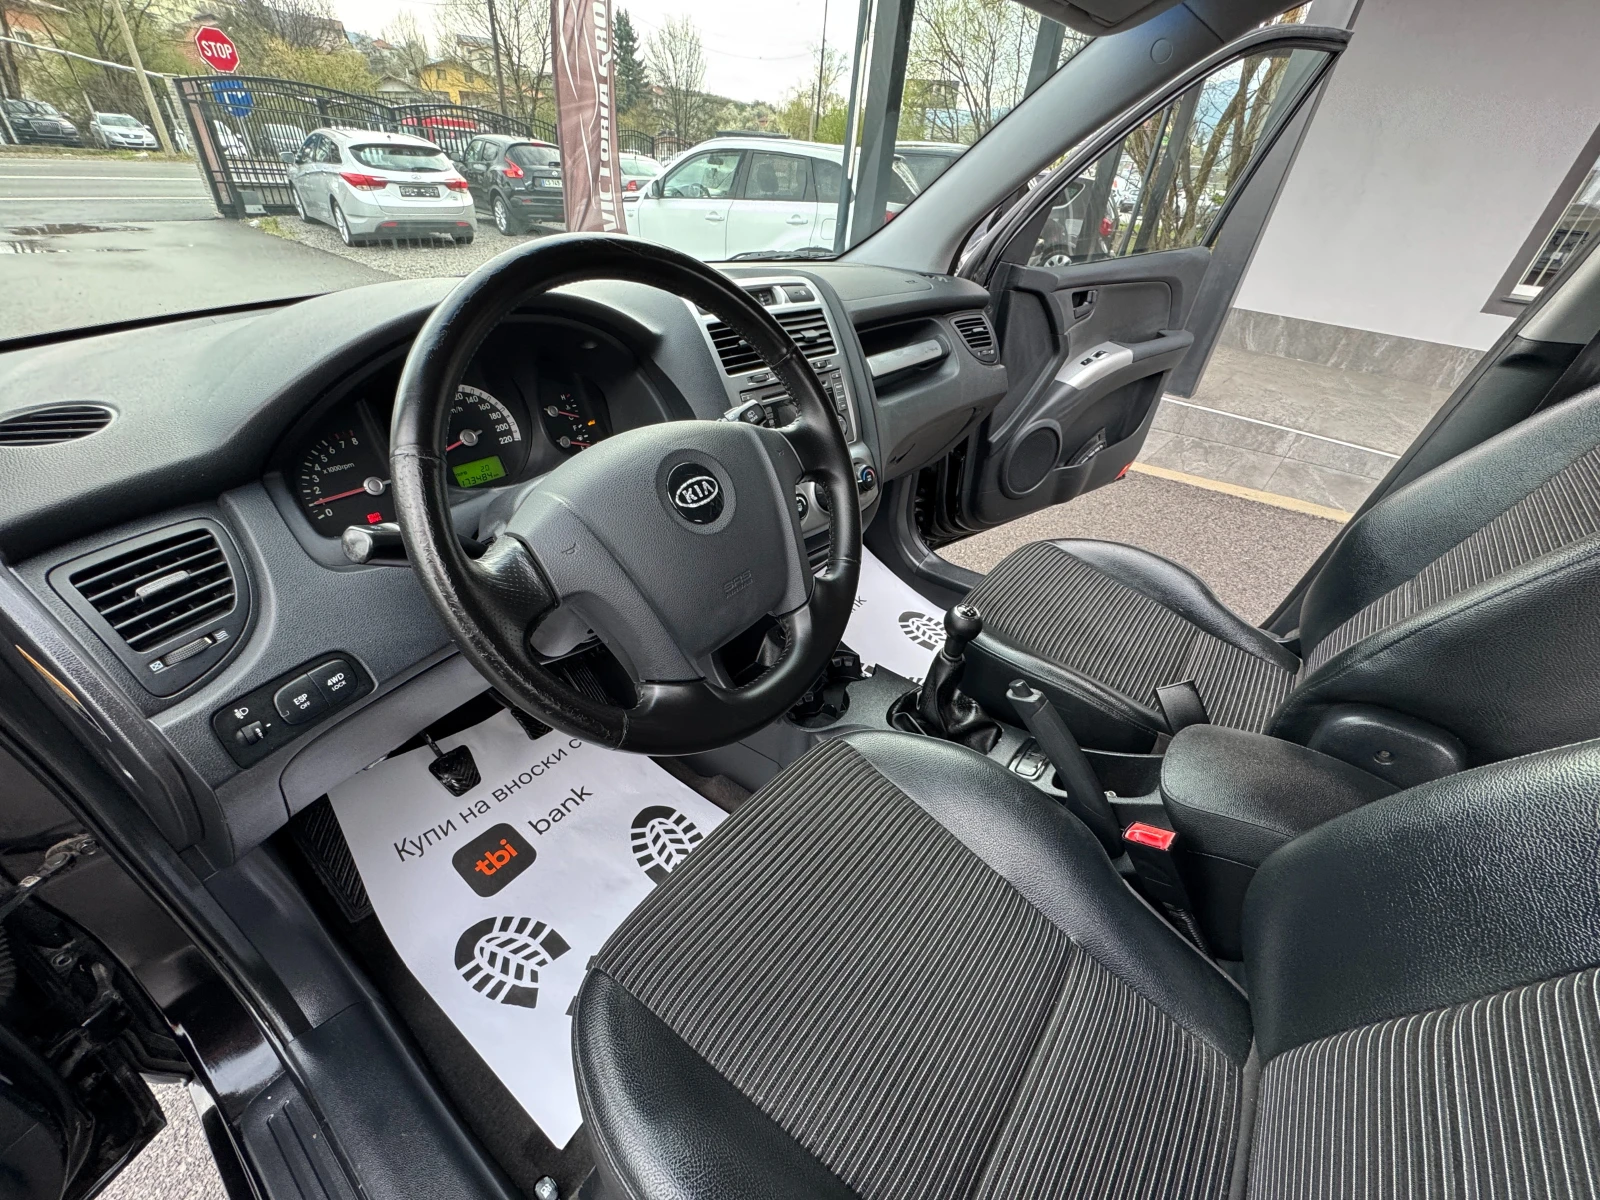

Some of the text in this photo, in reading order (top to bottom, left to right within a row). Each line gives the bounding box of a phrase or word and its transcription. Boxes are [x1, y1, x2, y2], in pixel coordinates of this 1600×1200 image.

[201, 40, 233, 59] STOP
[593, 0, 617, 232] VICTORIA GRO
[465, 395, 479, 404] 140
[478, 402, 491, 411] 160
[489, 411, 502, 420] 180
[495, 422, 509, 432] 200
[339, 440, 345, 449] 7
[351, 437, 359, 446] 8
[499, 435, 513, 445] 220
[328, 446, 336, 455] 6
[320, 454, 328, 463] 5
[314, 463, 321, 471] 4
[312, 475, 320, 483] 3
[461, 472, 493, 487] 173484
[313, 486, 321, 494] 2
[682, 480, 714, 504] KIA
[325, 508, 333, 517] 0
[327, 672, 344, 686] 4WD
[331, 680, 347, 691] LOCK
[293, 693, 308, 705] ESP
[300, 701, 310, 710] OFF
[393, 818, 458, 862] Купи
[459, 799, 491, 823] на
[491, 748, 568, 802] вноски
[474, 785, 594, 876] tbi bank
